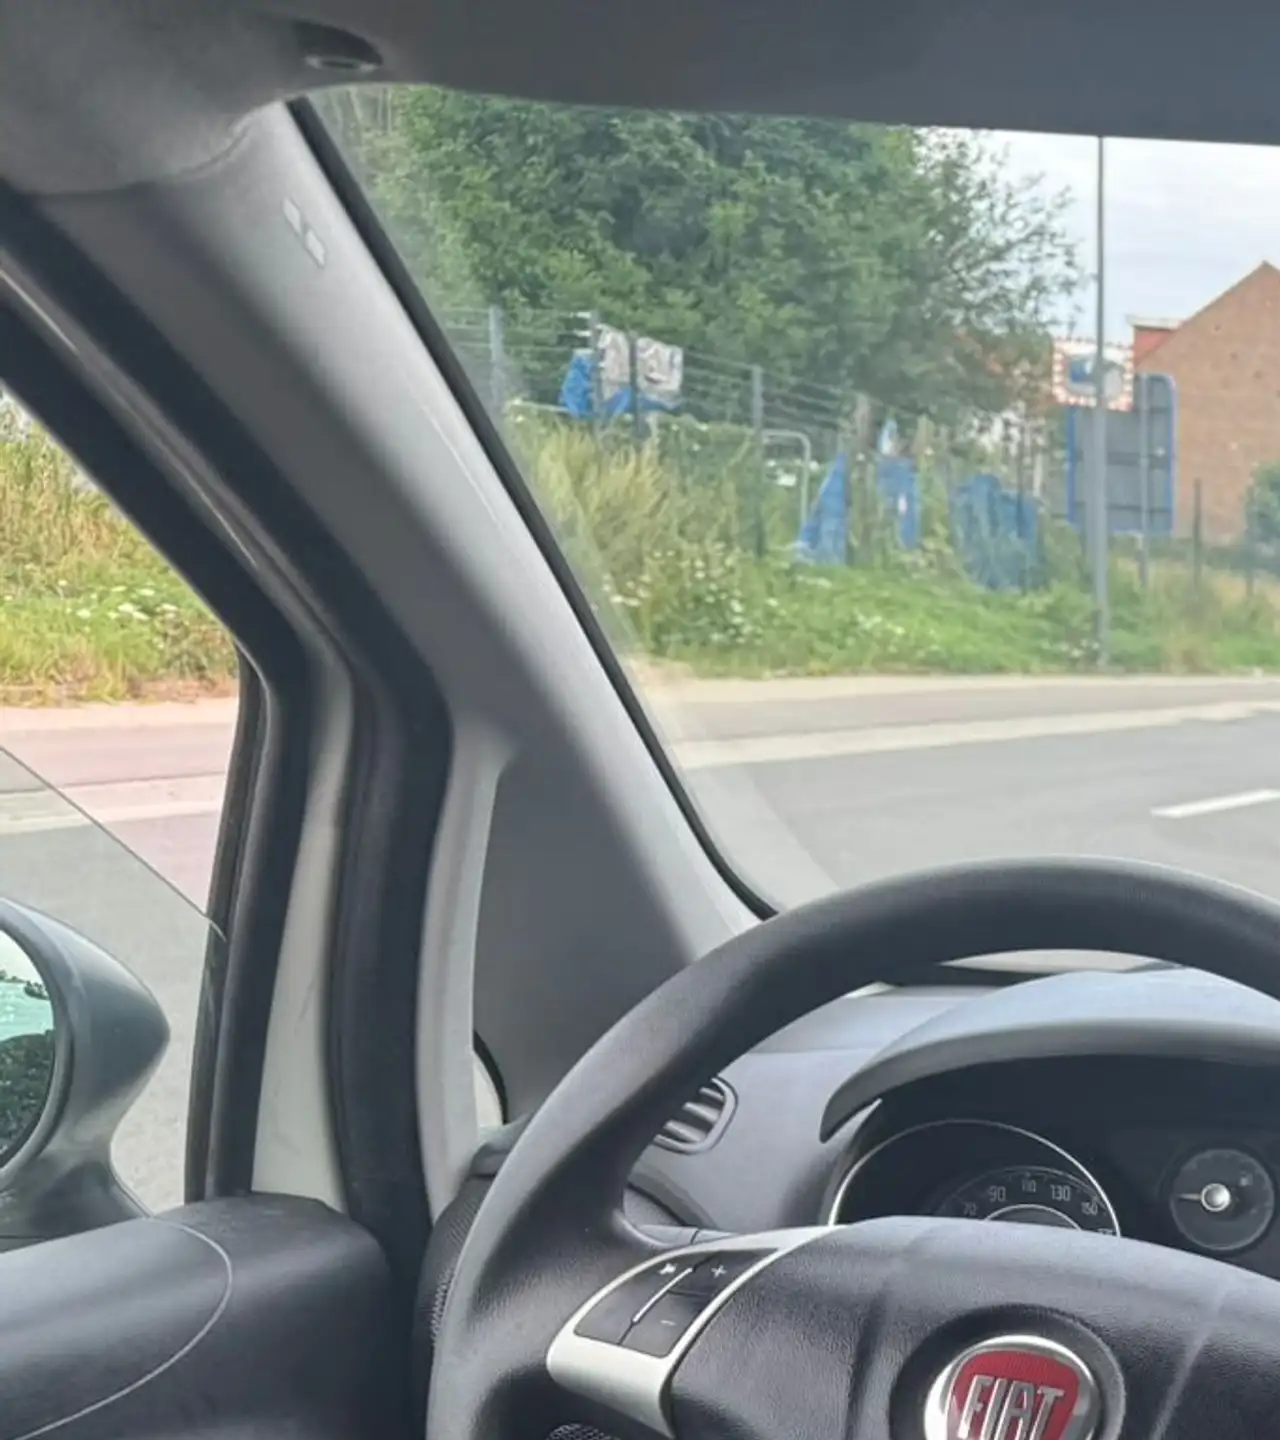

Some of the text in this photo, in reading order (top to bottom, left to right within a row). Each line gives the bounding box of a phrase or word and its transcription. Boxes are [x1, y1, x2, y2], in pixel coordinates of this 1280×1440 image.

[988, 1185, 1006, 1202] 90
[1021, 1179, 1037, 1193] 110
[1050, 1185, 1071, 1201] 130
